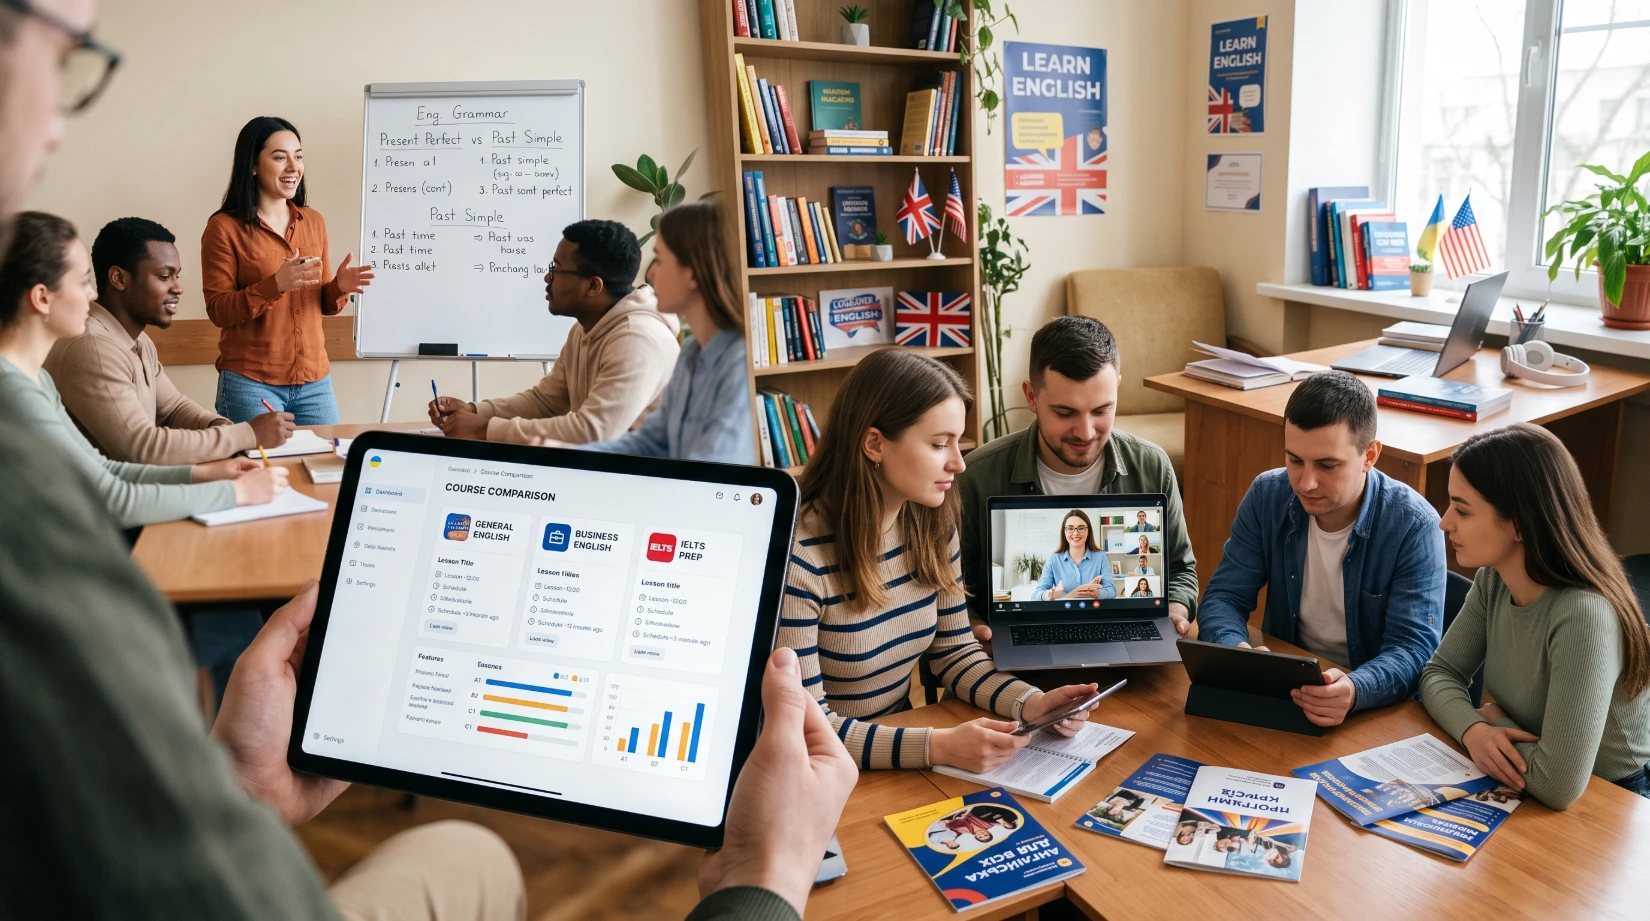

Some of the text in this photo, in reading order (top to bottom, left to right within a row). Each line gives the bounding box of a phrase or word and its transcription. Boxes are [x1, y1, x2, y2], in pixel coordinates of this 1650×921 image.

[1220, 36, 1256, 52] LEARN
[1022, 52, 1090, 75] LEARN
[1214, 52, 1262, 70] ENGLISH
[1012, 77, 1100, 100] ENGLISH
[417, 105, 509, 126] Eng. Grammar
[380, 130, 563, 146] Present Perfect vs Past Simple
[492, 153, 512, 164] Past
[518, 154, 549, 167] simple
[386, 182, 416, 192] Presens
[480, 186, 488, 194] 3.
[492, 184, 513, 194] Past
[542, 184, 572, 200] perfect
[430, 206, 504, 226] Past Simple
[384, 228, 406, 240] Past
[412, 230, 436, 240] time
[384, 244, 404, 254] Past
[409, 245, 433, 254] time
[834, 311, 878, 322] ENGLISH
[500, 471, 533, 480] Comparison
[446, 483, 556, 502] COURSE COMPARISON
[475, 520, 514, 531] GENERAL
[473, 531, 510, 542] ENGLISH
[575, 530, 618, 542] BUSINESS
[574, 541, 612, 552] ENGLISH
[650, 543, 673, 552] IELTS
[680, 541, 706, 550] IELTS
[679, 552, 703, 561] PREP
[538, 568, 560, 576] Lesson
[642, 579, 665, 588] Lesson
[418, 653, 444, 662] Features
[1016, 838, 1050, 854] ДЛЯ
[964, 847, 1059, 882] АНГЛІЙСЬКА
[978, 850, 1016, 868] ВСІХ
